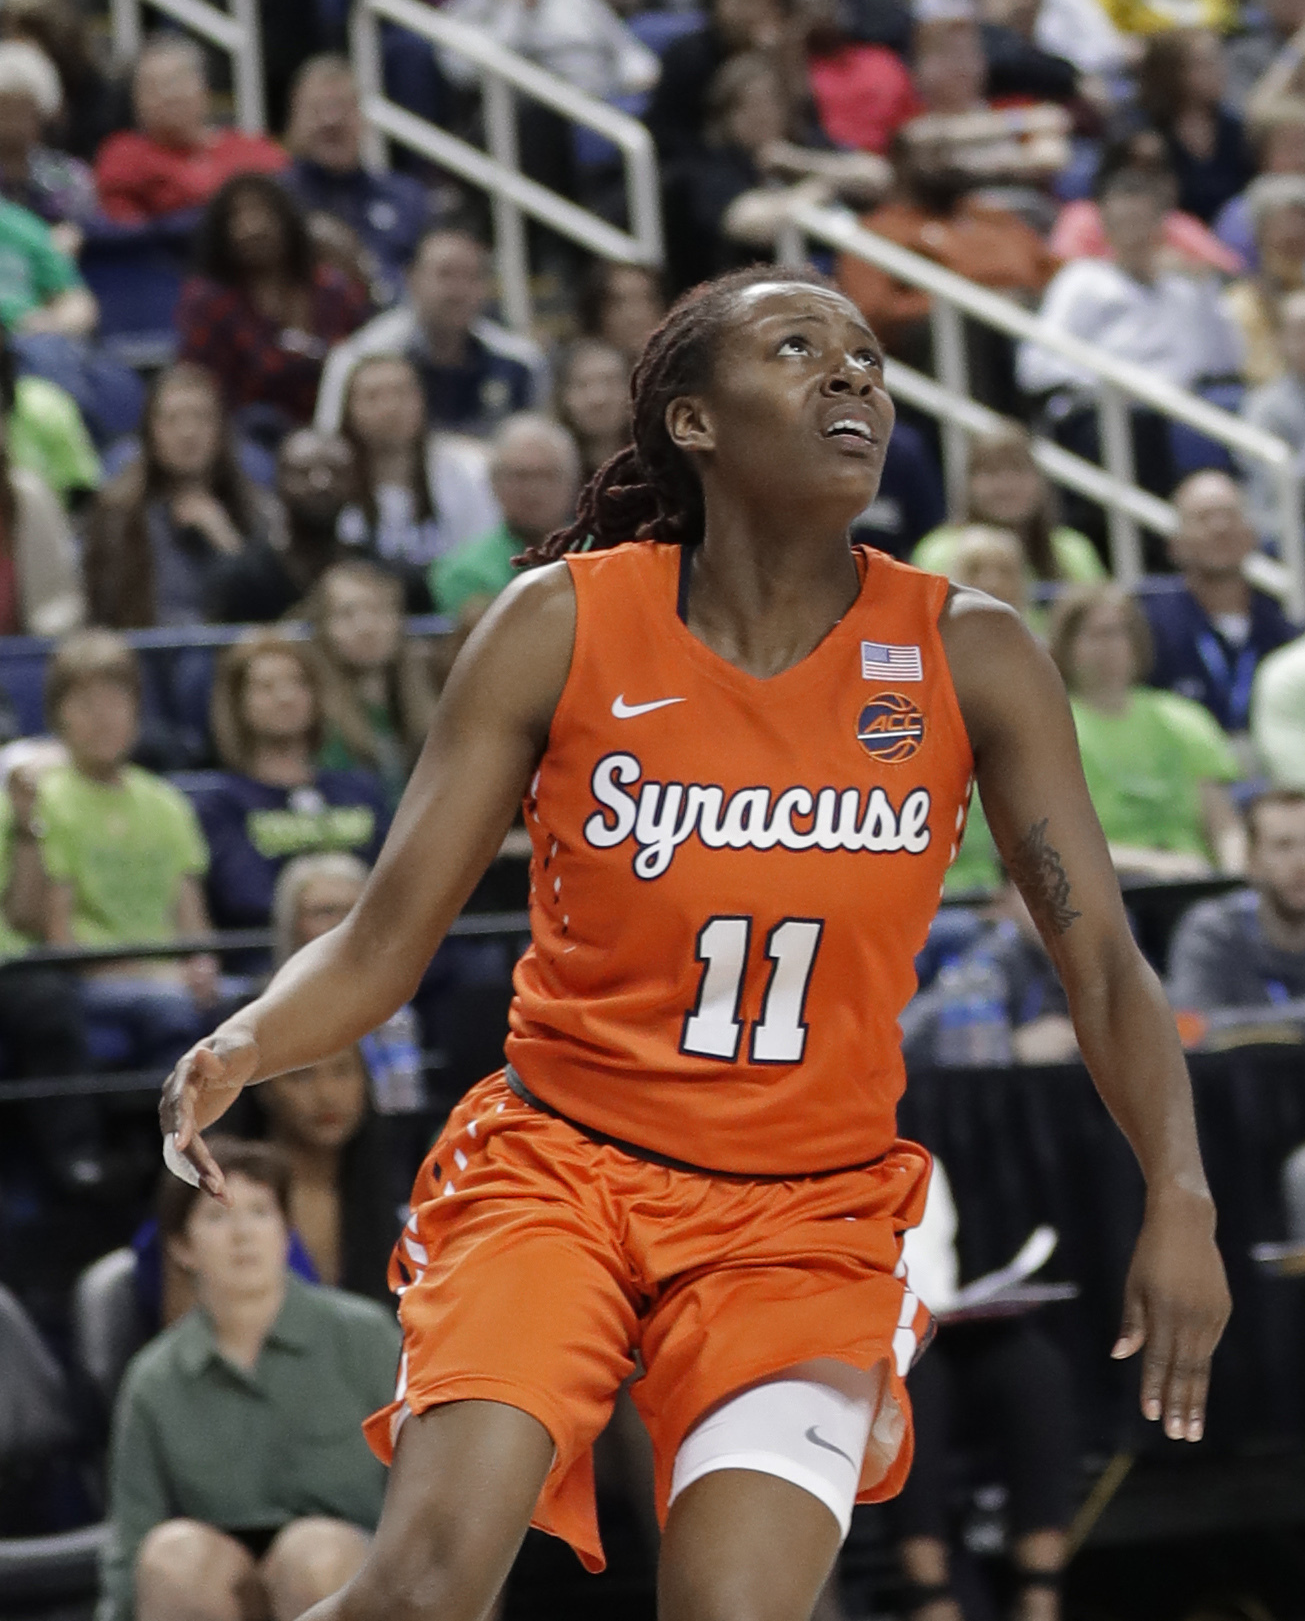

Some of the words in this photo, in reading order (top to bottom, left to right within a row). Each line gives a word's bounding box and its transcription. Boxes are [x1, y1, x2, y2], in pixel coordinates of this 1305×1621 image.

[864, 712, 924, 733] ACC
[583, 751, 931, 880] Syracuse
[678, 915, 825, 1065] 11
